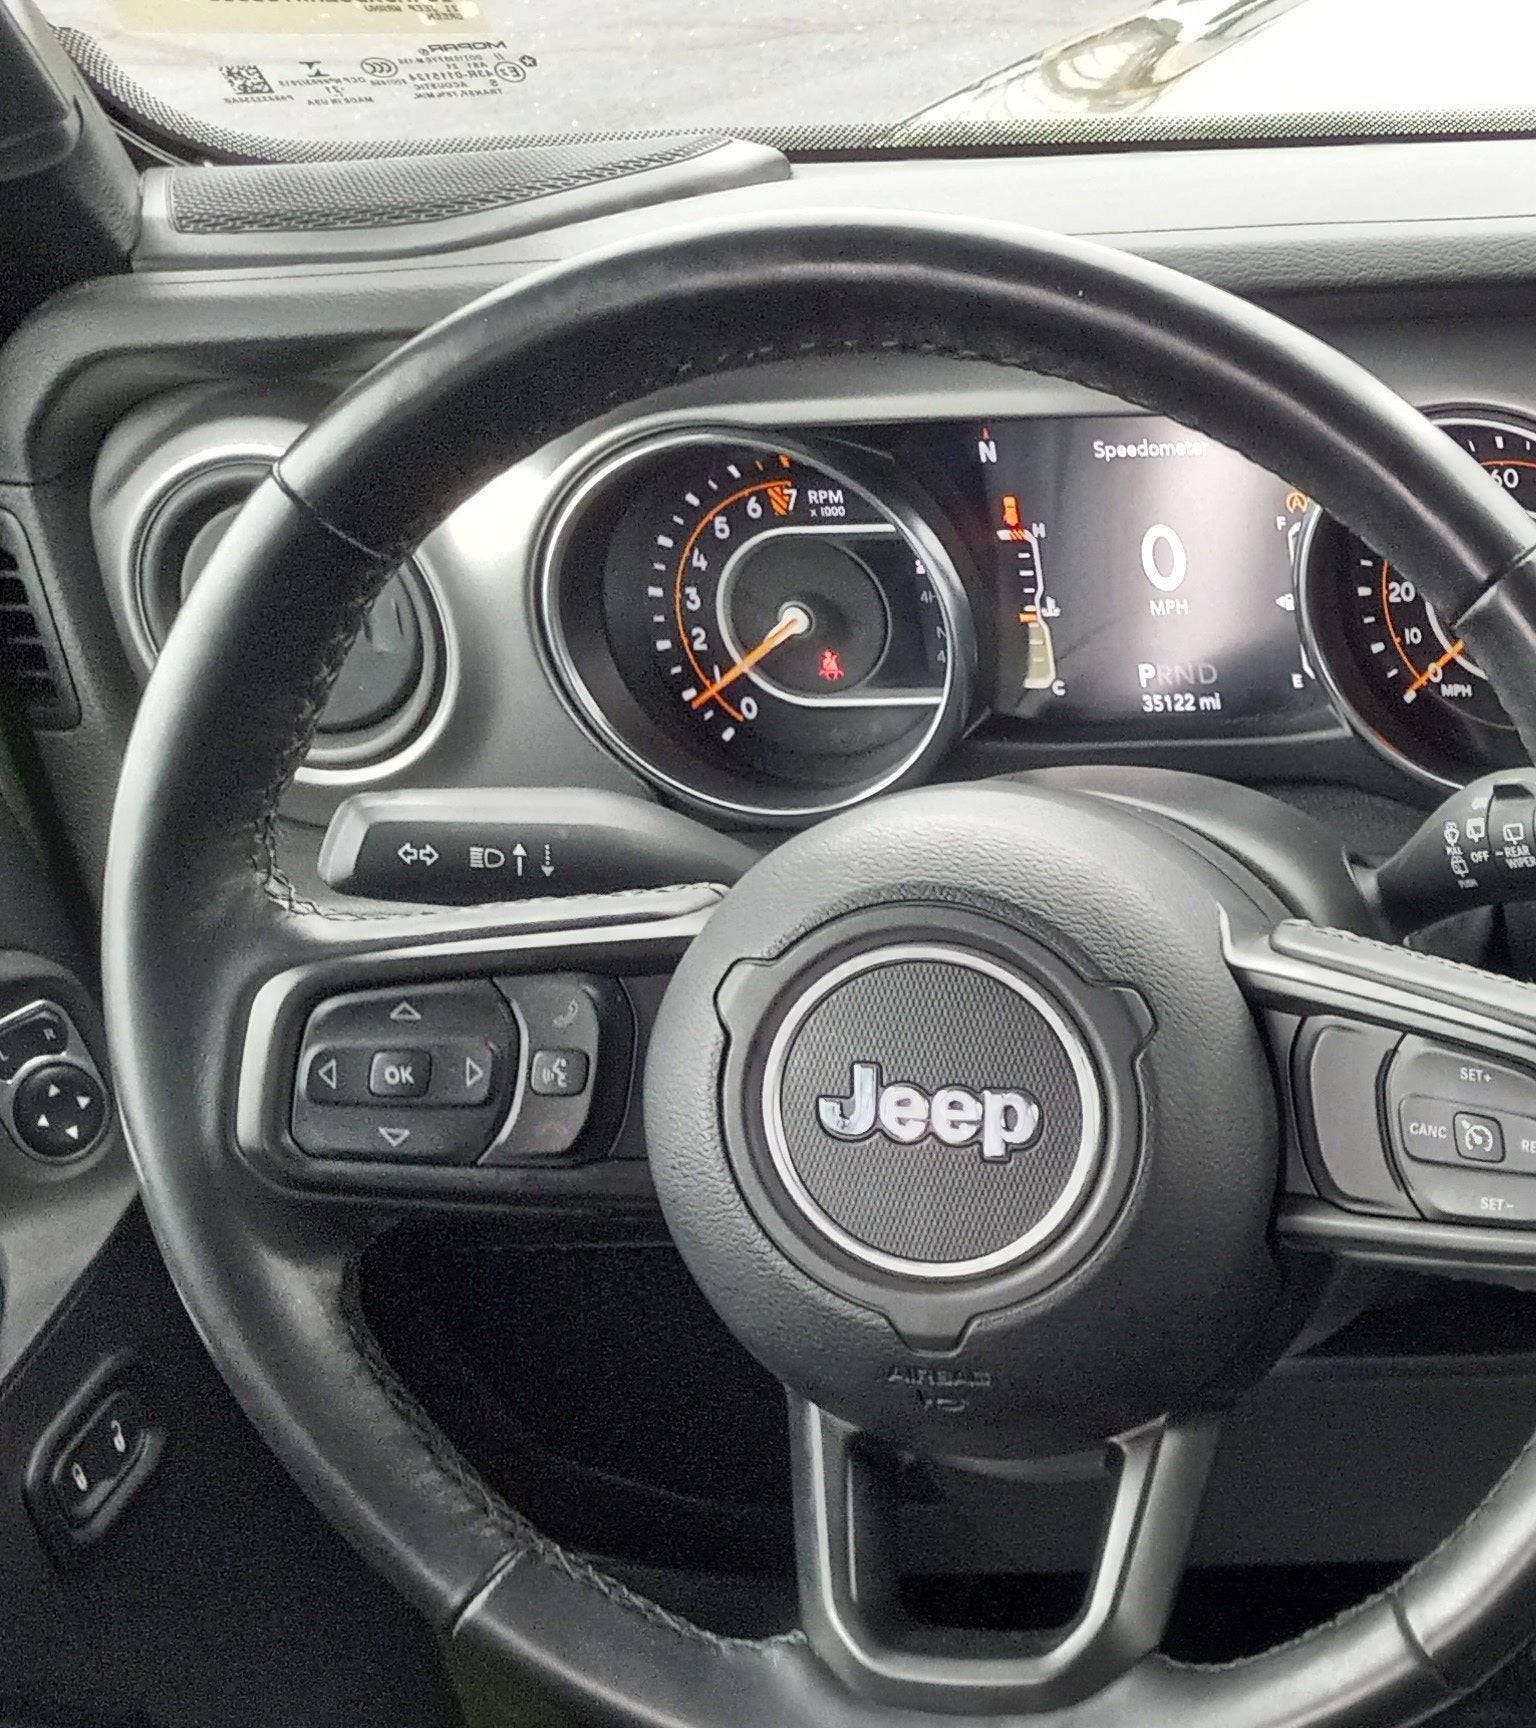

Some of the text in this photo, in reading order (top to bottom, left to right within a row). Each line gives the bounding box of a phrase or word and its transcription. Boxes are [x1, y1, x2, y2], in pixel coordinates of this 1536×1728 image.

[978, 441, 997, 463] N
[1093, 440, 1209, 462] Speedometer
[1490, 468, 1519, 489] 60
[807, 489, 845, 506] RPM
[746, 496, 762, 519] 6
[821, 505, 846, 517] 1000
[714, 516, 730, 539] 5
[1032, 523, 1046, 539] H
[1276, 516, 1287, 531] F
[692, 550, 708, 571] 4
[1141, 524, 1187, 592] 0
[685, 587, 701, 610] 3
[1388, 582, 1416, 602] 20
[1149, 599, 1189, 616] MPH
[691, 628, 708, 651] 2
[1404, 627, 1422, 645] 10
[1052, 680, 1066, 696] C
[1291, 673, 1303, 689] E
[1441, 684, 1472, 697] MPH
[740, 697, 758, 720] 0
[1141, 693, 1197, 712] 35122
[1470, 850, 1489, 864] OFF
[1503, 844, 1531, 858] REAR
[384, 1064, 415, 1086] OK
[818, 1062, 1043, 1162] Jeep
[1409, 1122, 1447, 1139] CANC
